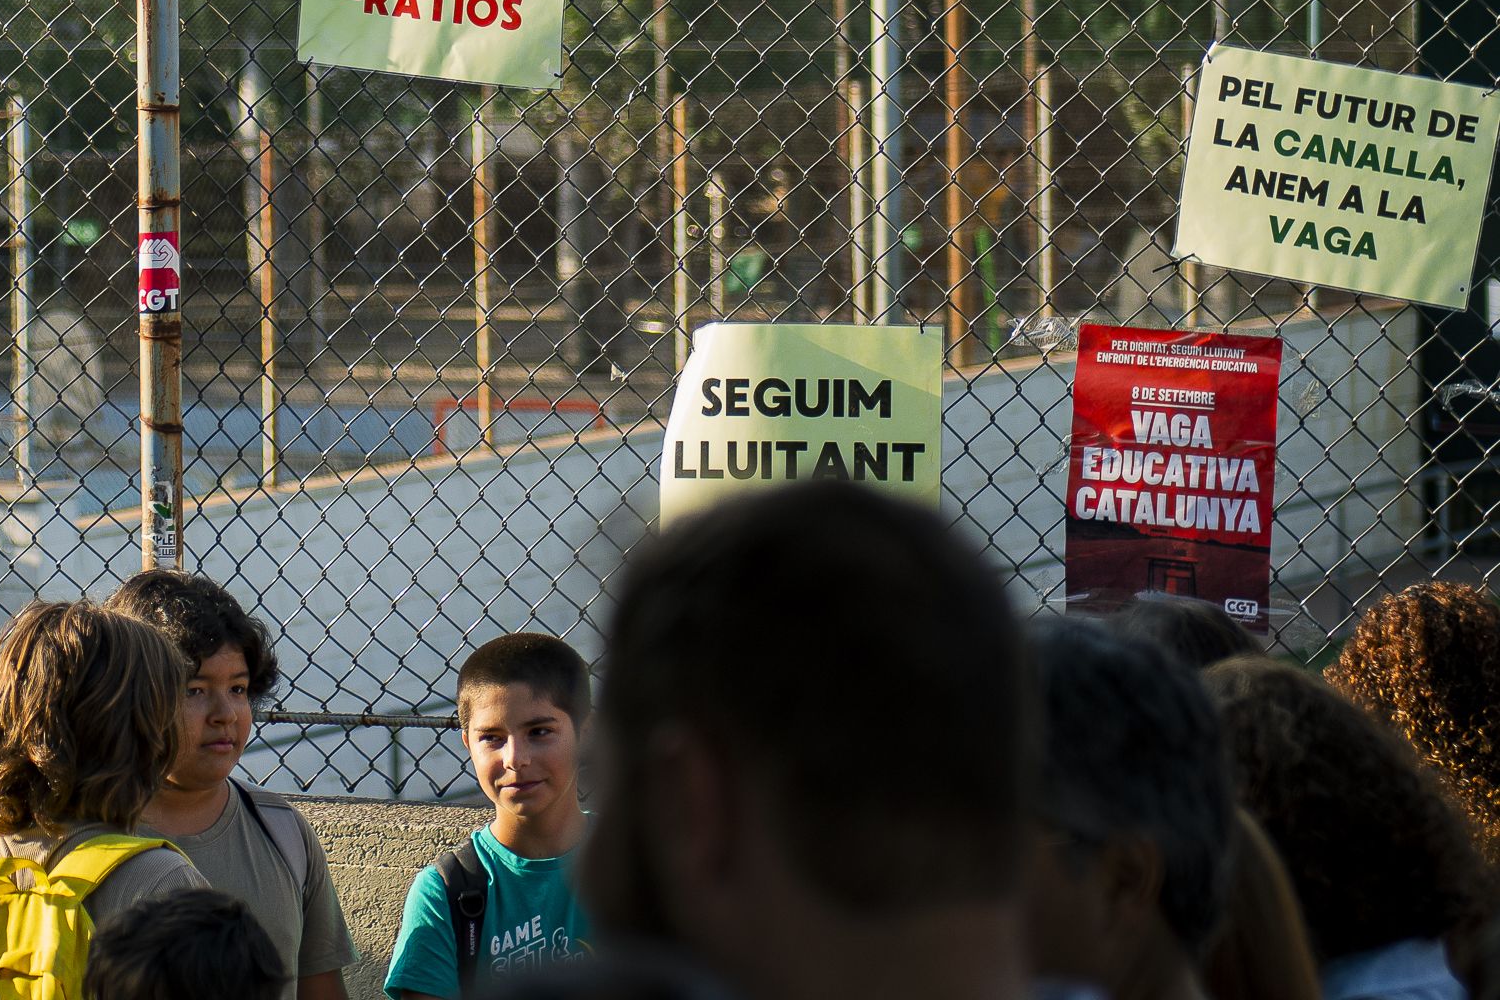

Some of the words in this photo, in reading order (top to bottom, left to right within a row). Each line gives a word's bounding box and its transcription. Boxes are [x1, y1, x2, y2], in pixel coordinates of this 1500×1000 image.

[1218, 74, 1282, 111] PEL
[1294, 87, 1416, 134] FUTUR
[1427, 109, 1479, 144] DE
[1212, 118, 1260, 152] LA
[1273, 129, 1465, 191] CANALLA,
[1224, 165, 1329, 208] ANEM
[1338, 184, 1365, 214] A
[1376, 190, 1426, 225] LA
[1269, 214, 1378, 261] VAGA
[138, 288, 179, 312] CGT
[1096, 352, 1135, 365] ENFRONT
[1137, 354, 1149, 366] DE
[1211, 360, 1258, 373] EDUCATIVA
[1111, 340, 1128, 351] PER
[1129, 340, 1169, 355] DIGNITAT,
[1170, 343, 1202, 357] SEGUIM
[1204, 347, 1246, 360] LLUITANT
[701, 377, 892, 419] SEGUIM
[1131, 386, 1139, 400] 8
[1141, 387, 1156, 401] DE
[1158, 388, 1215, 405] SETEMBRE
[1130, 410, 1213, 449] VAGA
[674, 440, 925, 482] LLUITANT
[1082, 446, 1260, 493] EDUCATIVA
[1075, 486, 1261, 534] CATALUNYA
[1227, 601, 1256, 613] CGT
[490, 915, 542, 956] GAME
